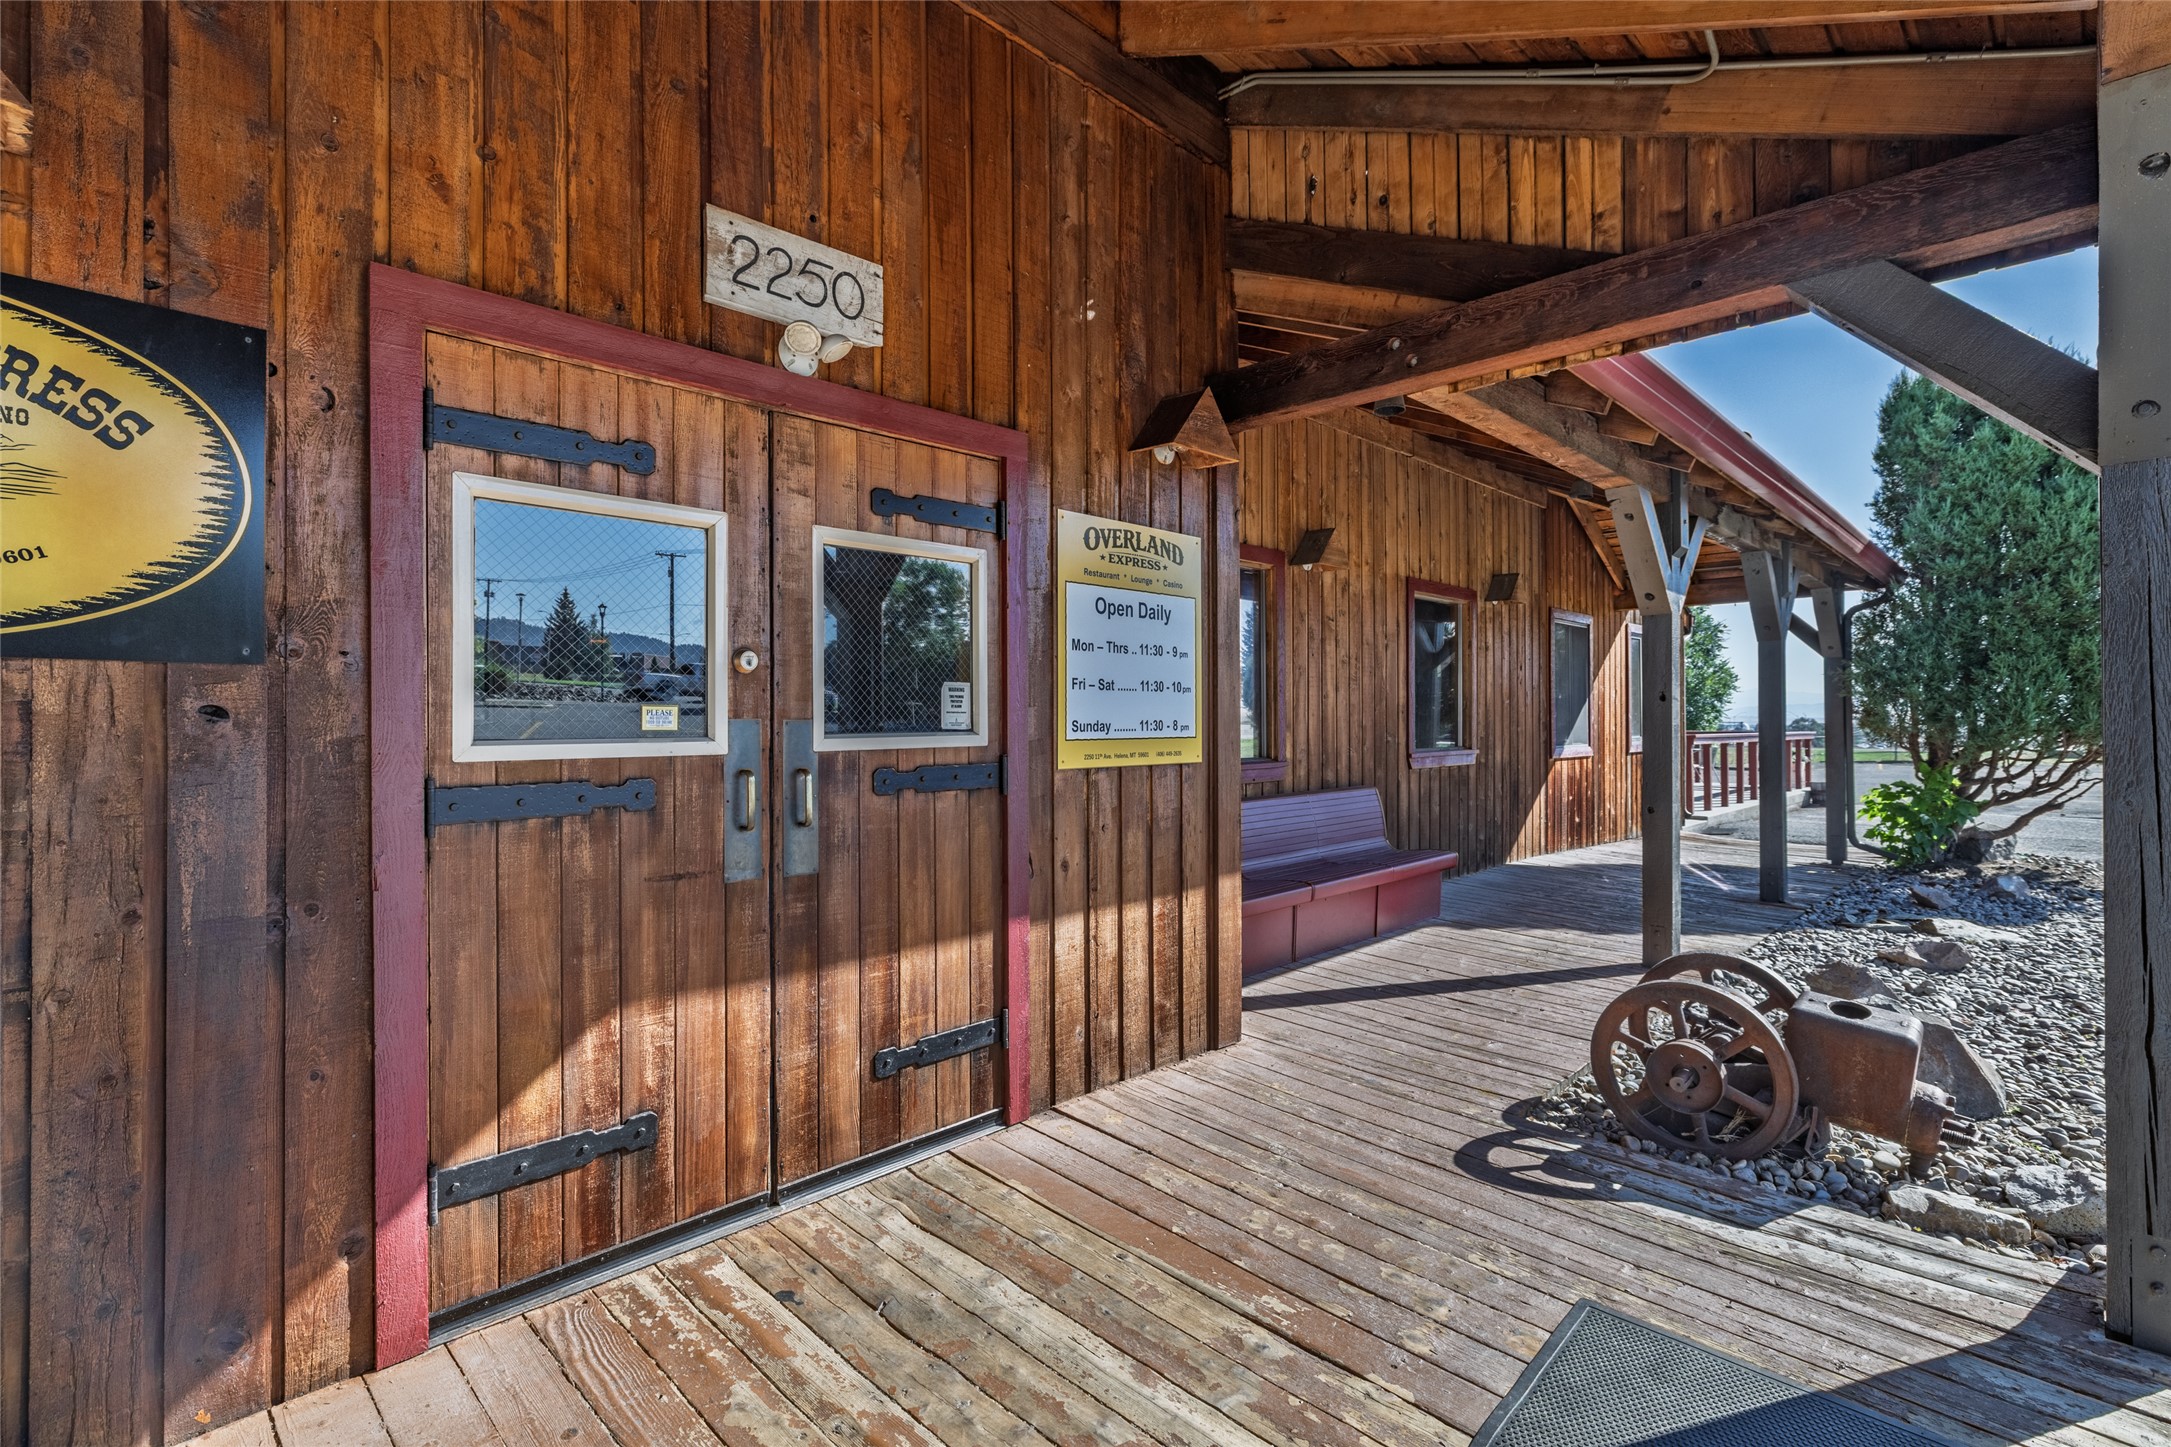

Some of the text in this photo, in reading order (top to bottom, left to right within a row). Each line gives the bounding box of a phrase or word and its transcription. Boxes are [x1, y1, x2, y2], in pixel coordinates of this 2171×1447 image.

[732, 234, 865, 321] 2250
[0, 344, 155, 451] RESS
[0, 545, 49, 564] 601
[1082, 526, 1184, 566] OVERLAND
[1108, 553, 1161, 571] EXPRESS
[1083, 567, 1183, 589] Restaurant Lounge Casino
[1095, 596, 1171, 626] Open Daily
[1071, 638, 1094, 652] Mon
[1106, 640, 1129, 655] Thrs
[1139, 643, 1164, 657] 11:30
[1172, 646, 1178, 658] 9
[1179, 652, 1189, 660] pm
[1071, 677, 1086, 690] Fri
[1098, 678, 1115, 691] Sat
[1139, 680, 1164, 693] 11:30
[1171, 681, 1182, 693] 10
[1182, 687, 1192, 695] pm
[1071, 720, 1111, 735] Sunday
[1139, 719, 1164, 732] 11:30
[1172, 719, 1179, 731] 8
[1180, 725, 1190, 733] pm
